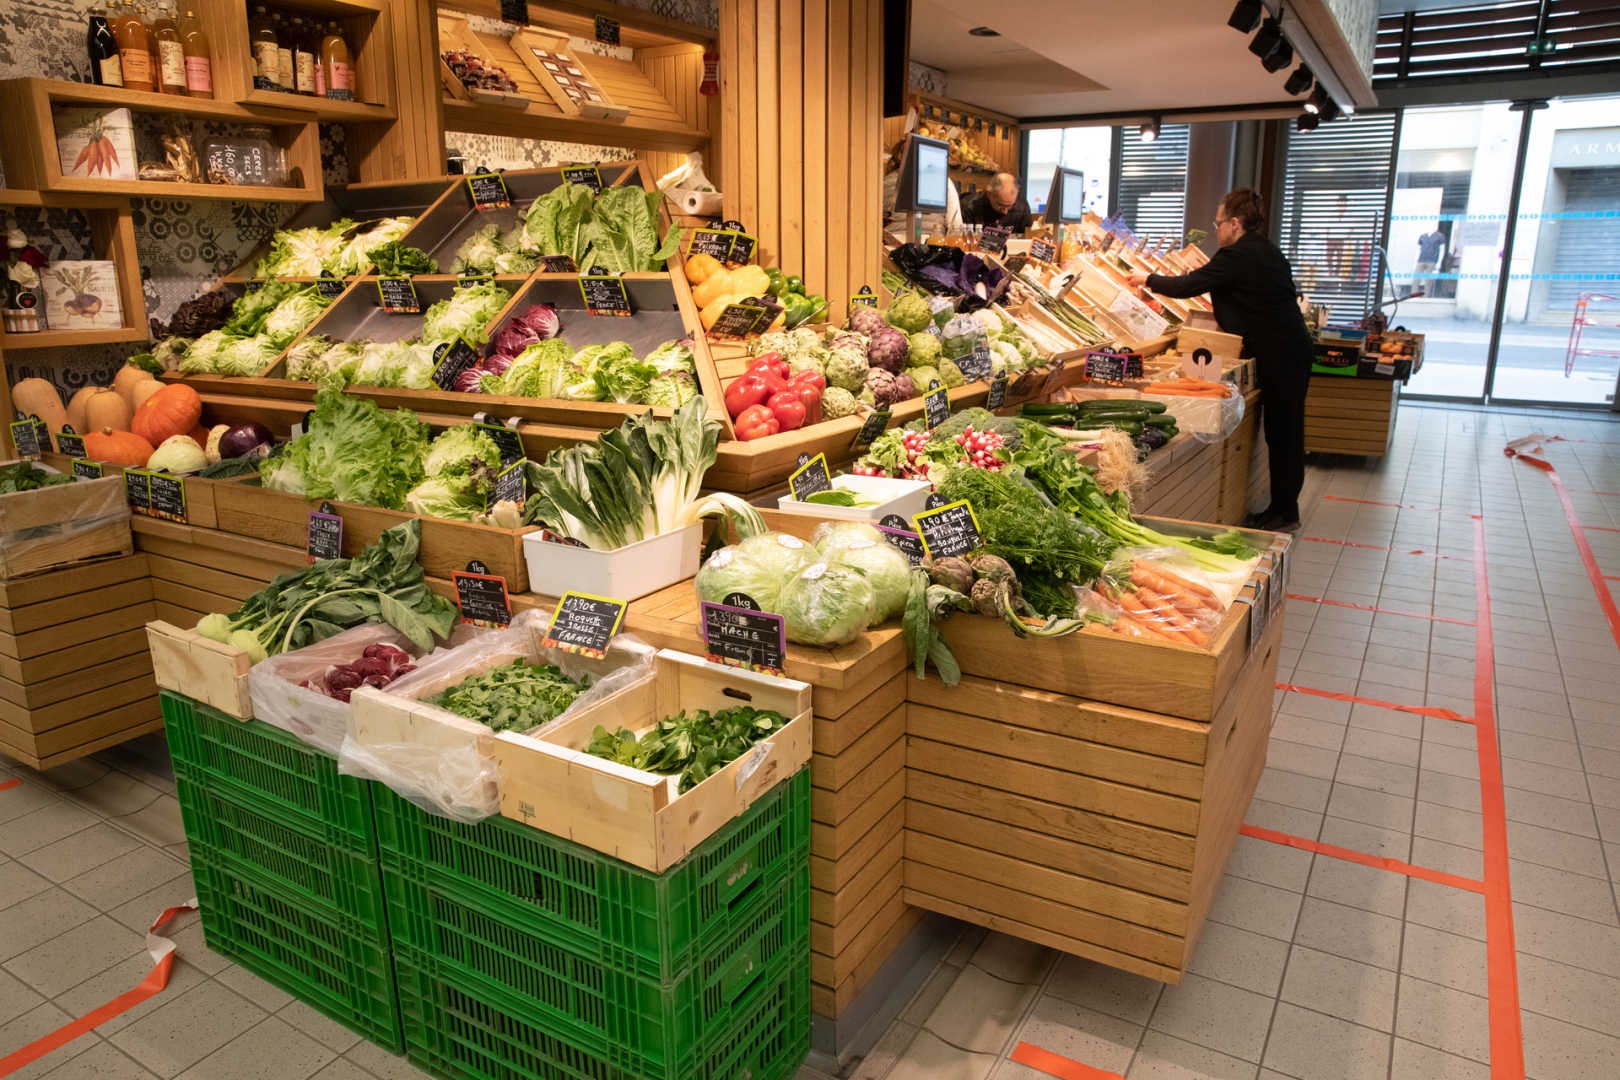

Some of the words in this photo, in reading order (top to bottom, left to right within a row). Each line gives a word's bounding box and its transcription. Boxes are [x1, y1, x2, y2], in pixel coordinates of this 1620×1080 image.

[471, 562, 485, 575] 1kg
[732, 595, 750, 610] 1kg
[558, 630, 593, 645] FRANCE
